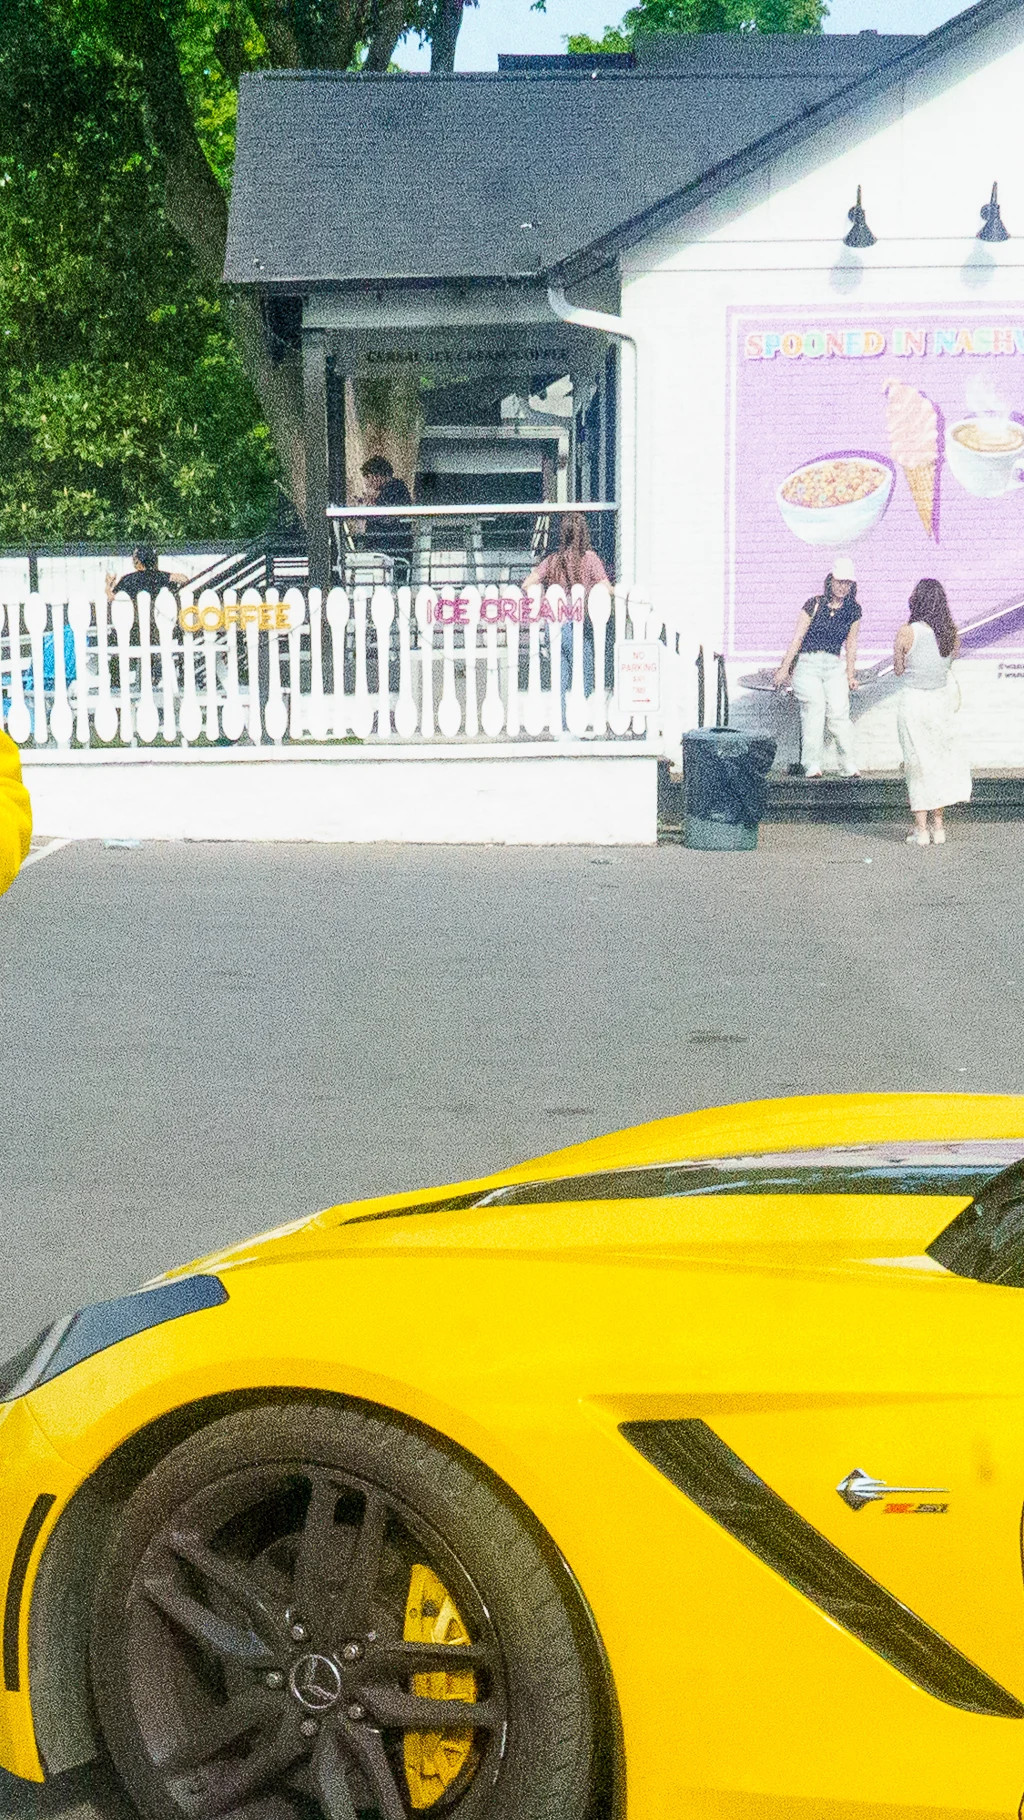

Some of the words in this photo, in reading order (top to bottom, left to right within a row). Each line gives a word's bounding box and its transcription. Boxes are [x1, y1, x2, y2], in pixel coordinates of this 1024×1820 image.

[746, 332, 884, 357] SPOONED
[894, 331, 924, 355] IN
[179, 603, 292, 632] COFFEE
[426, 599, 470, 625] ICE
[480, 598, 584, 624] CREAM
[621, 663, 657, 672] PARKING
[632, 651, 645, 660] NO
